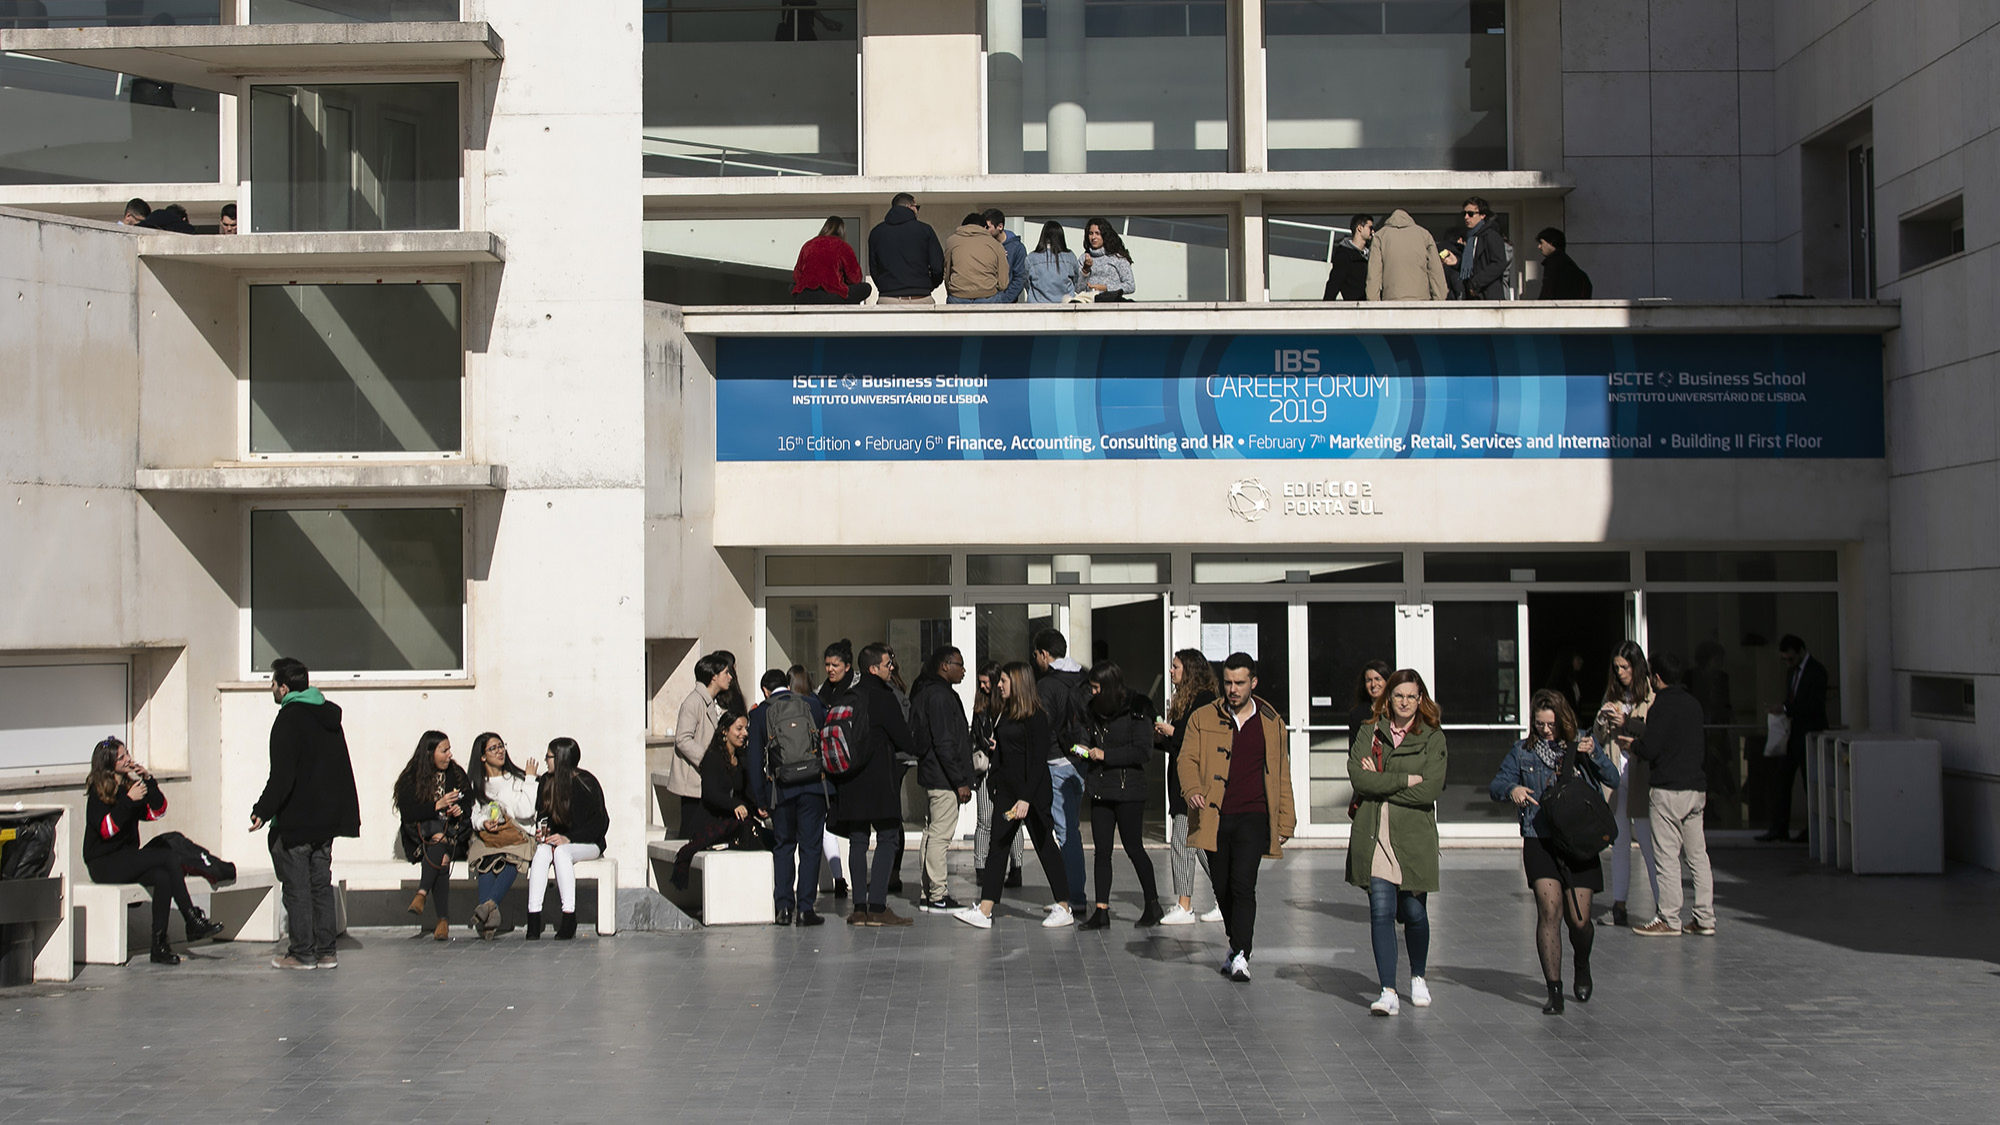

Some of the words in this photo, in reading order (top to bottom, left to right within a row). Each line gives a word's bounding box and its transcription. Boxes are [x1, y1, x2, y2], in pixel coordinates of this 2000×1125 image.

[1274, 349, 1320, 373] IBS
[792, 374, 838, 388] ISCTE
[861, 374, 933, 388] Business
[935, 374, 989, 388] School
[1206, 374, 1299, 398] CAREER
[1304, 374, 1390, 398] FORUM
[1608, 372, 1654, 386] ISCTE
[1679, 372, 1750, 386] Business
[1752, 372, 1807, 386] School
[792, 394, 850, 405] INSTITUTO
[850, 392, 932, 405] UNIVERSITÁRIO
[934, 394, 948, 405] DE
[949, 394, 989, 405] LISBOA
[1608, 392, 1666, 402] INSTITUTO
[1667, 390, 1749, 402] UNIVERSITÁRIO
[1751, 392, 1766, 402] DE
[1767, 392, 1807, 402] LISBOA
[1269, 399, 1327, 423] 2019
[806, 435, 851, 451] Edition
[865, 435, 922, 454] February
[947, 435, 1007, 452] Finance,
[1010, 435, 1096, 452] Accounting,
[1099, 435, 1177, 453] Consulting
[1180, 434, 1208, 450] and
[1212, 434, 1234, 450] HR
[1248, 434, 1306, 452] February
[1329, 434, 1406, 452] Marketing,
[1410, 434, 1457, 451] Retail,
[1460, 434, 1523, 450] Services
[1526, 434, 1554, 450] and
[1558, 434, 1651, 450] International
[1671, 433, 1731, 451] Building
[1735, 434, 1743, 449] II
[1748, 433, 1782, 449] First
[1785, 433, 1823, 449] Floor
[1283, 479, 1358, 498] EDIFÍCIO
[1361, 482, 1373, 498] 2
[1284, 500, 1344, 516] PORTA
[1349, 500, 1384, 516] SUL
